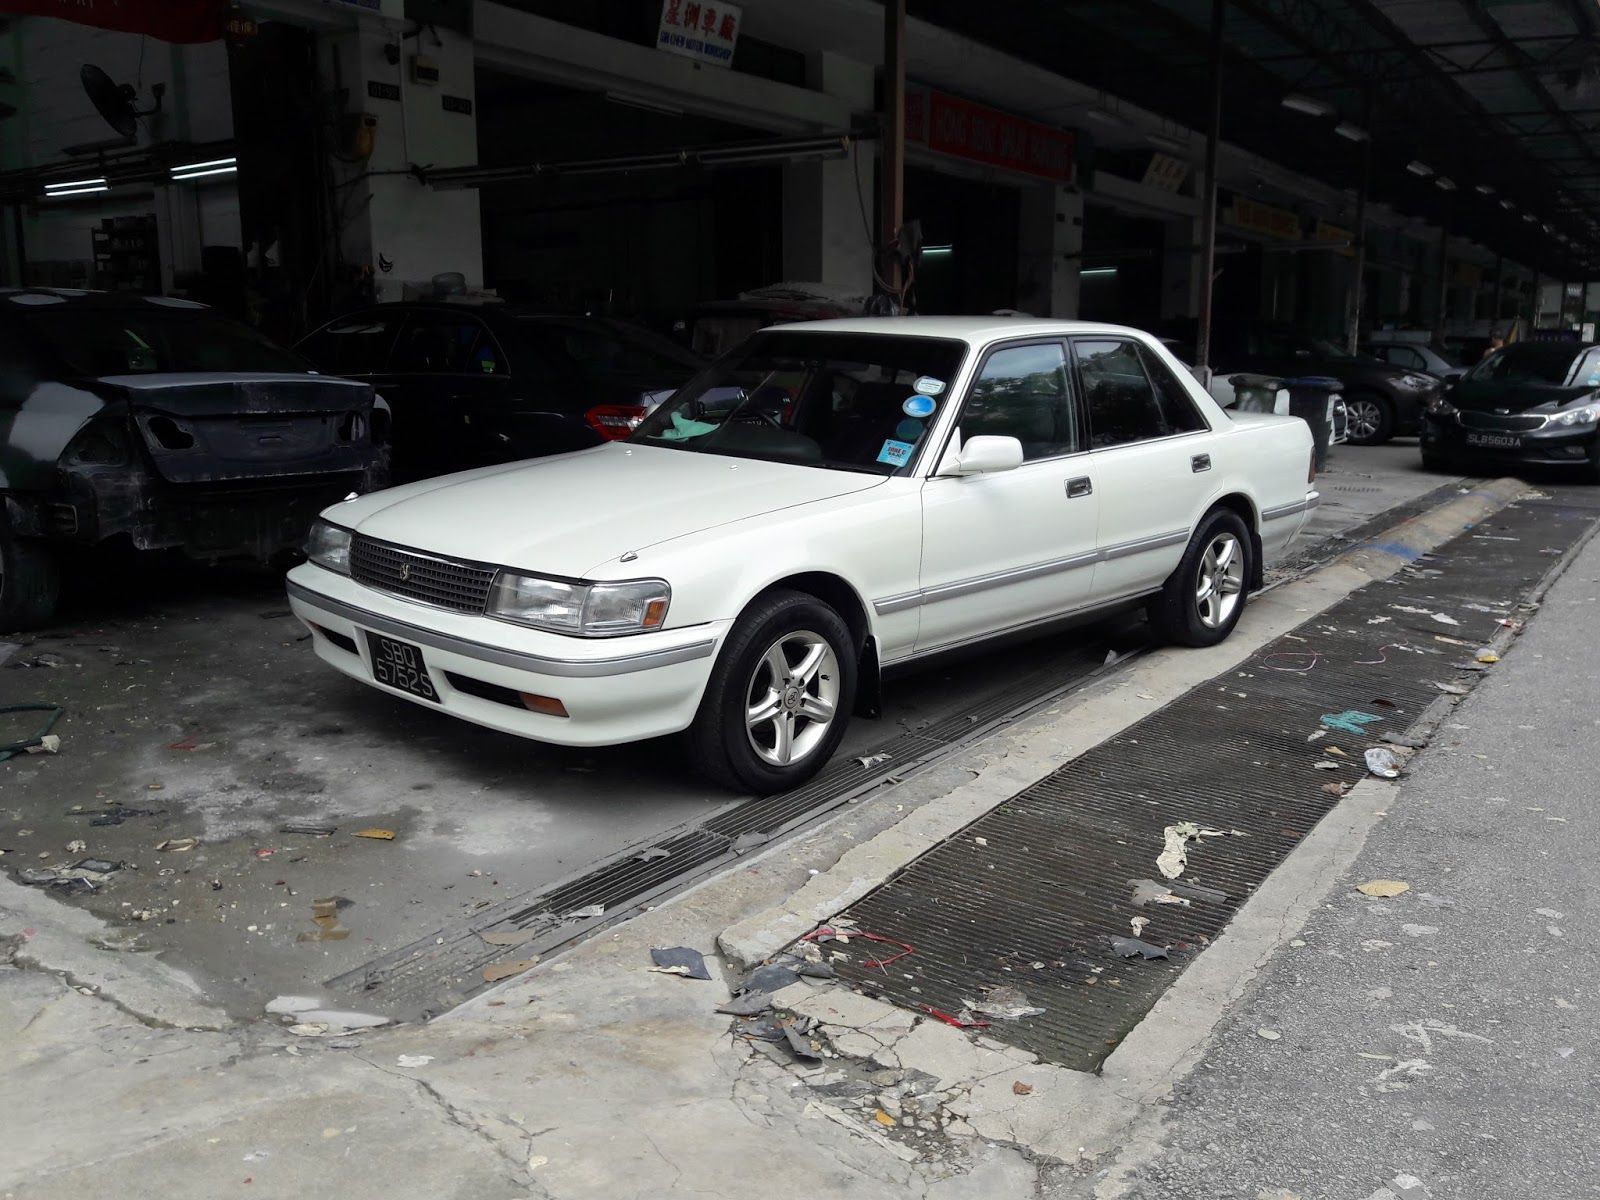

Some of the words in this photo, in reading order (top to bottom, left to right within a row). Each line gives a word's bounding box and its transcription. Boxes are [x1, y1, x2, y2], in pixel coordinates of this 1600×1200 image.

[686, 38, 704, 52] MOTOR
[704, 43, 732, 60] WORKSHOP
[1468, 433, 1521, 448] SLB5603A
[381, 639, 416, 669] SBQ
[377, 658, 433, 697] 5752S
